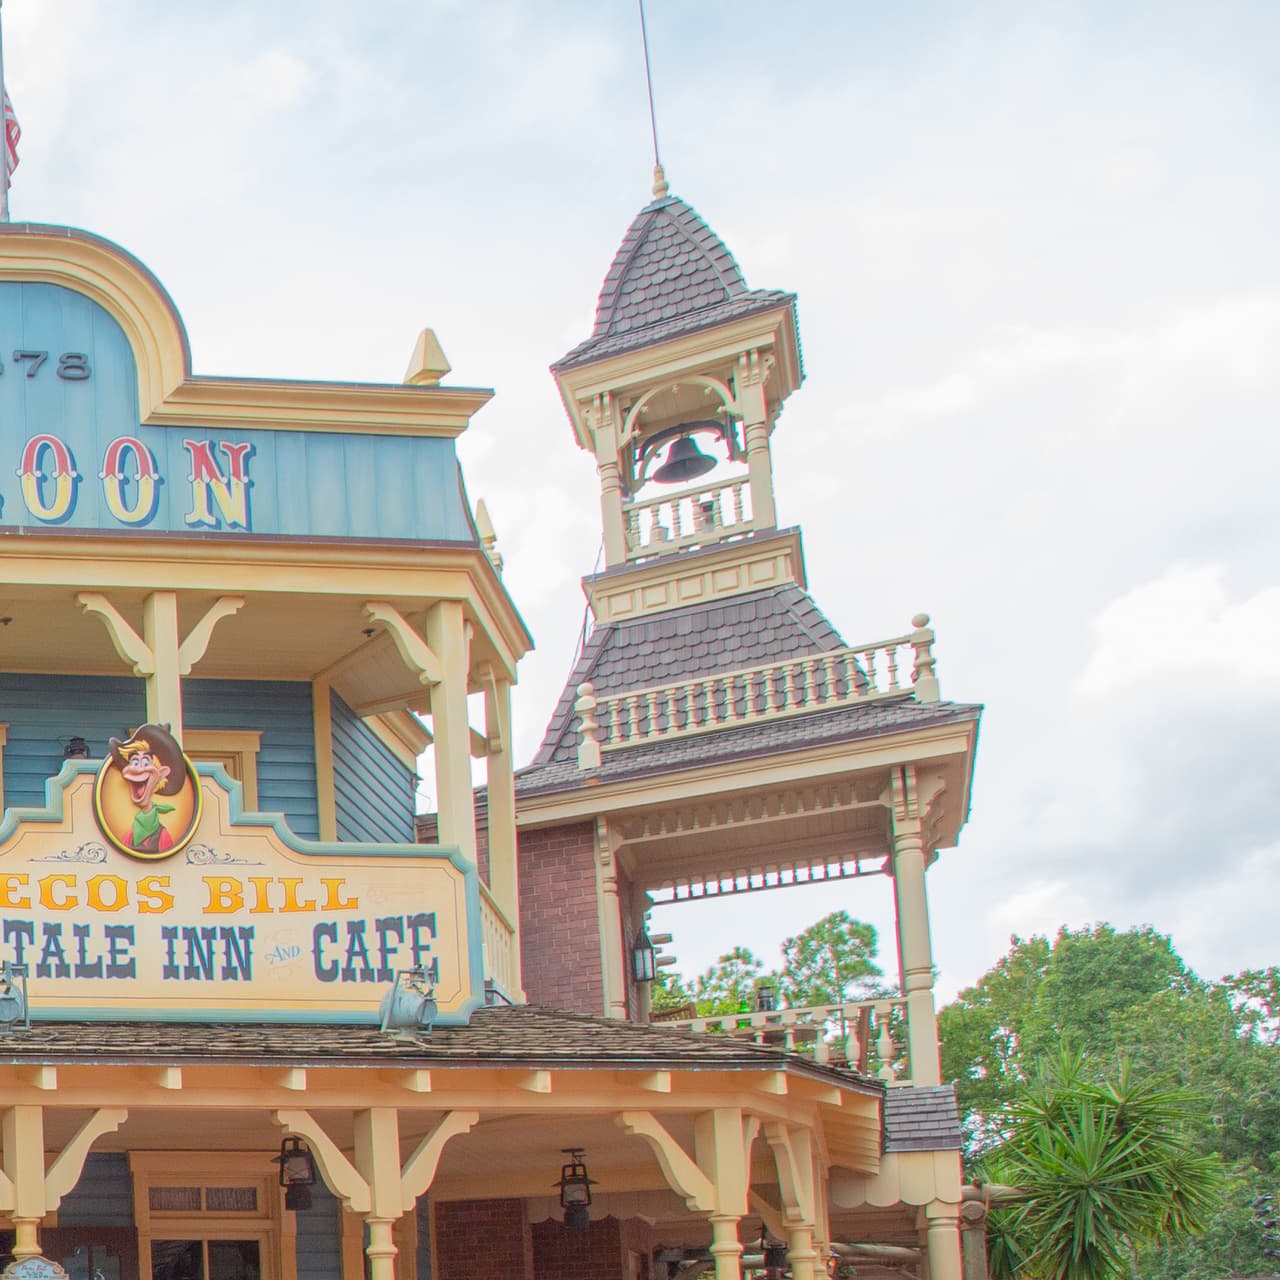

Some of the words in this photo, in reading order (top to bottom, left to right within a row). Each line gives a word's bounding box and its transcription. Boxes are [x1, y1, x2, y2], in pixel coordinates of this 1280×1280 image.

[203, 876, 359, 915] BILL
[2, 918, 137, 980] TALE
[161, 925, 256, 982] INN
[311, 912, 439, 984] CAFE
